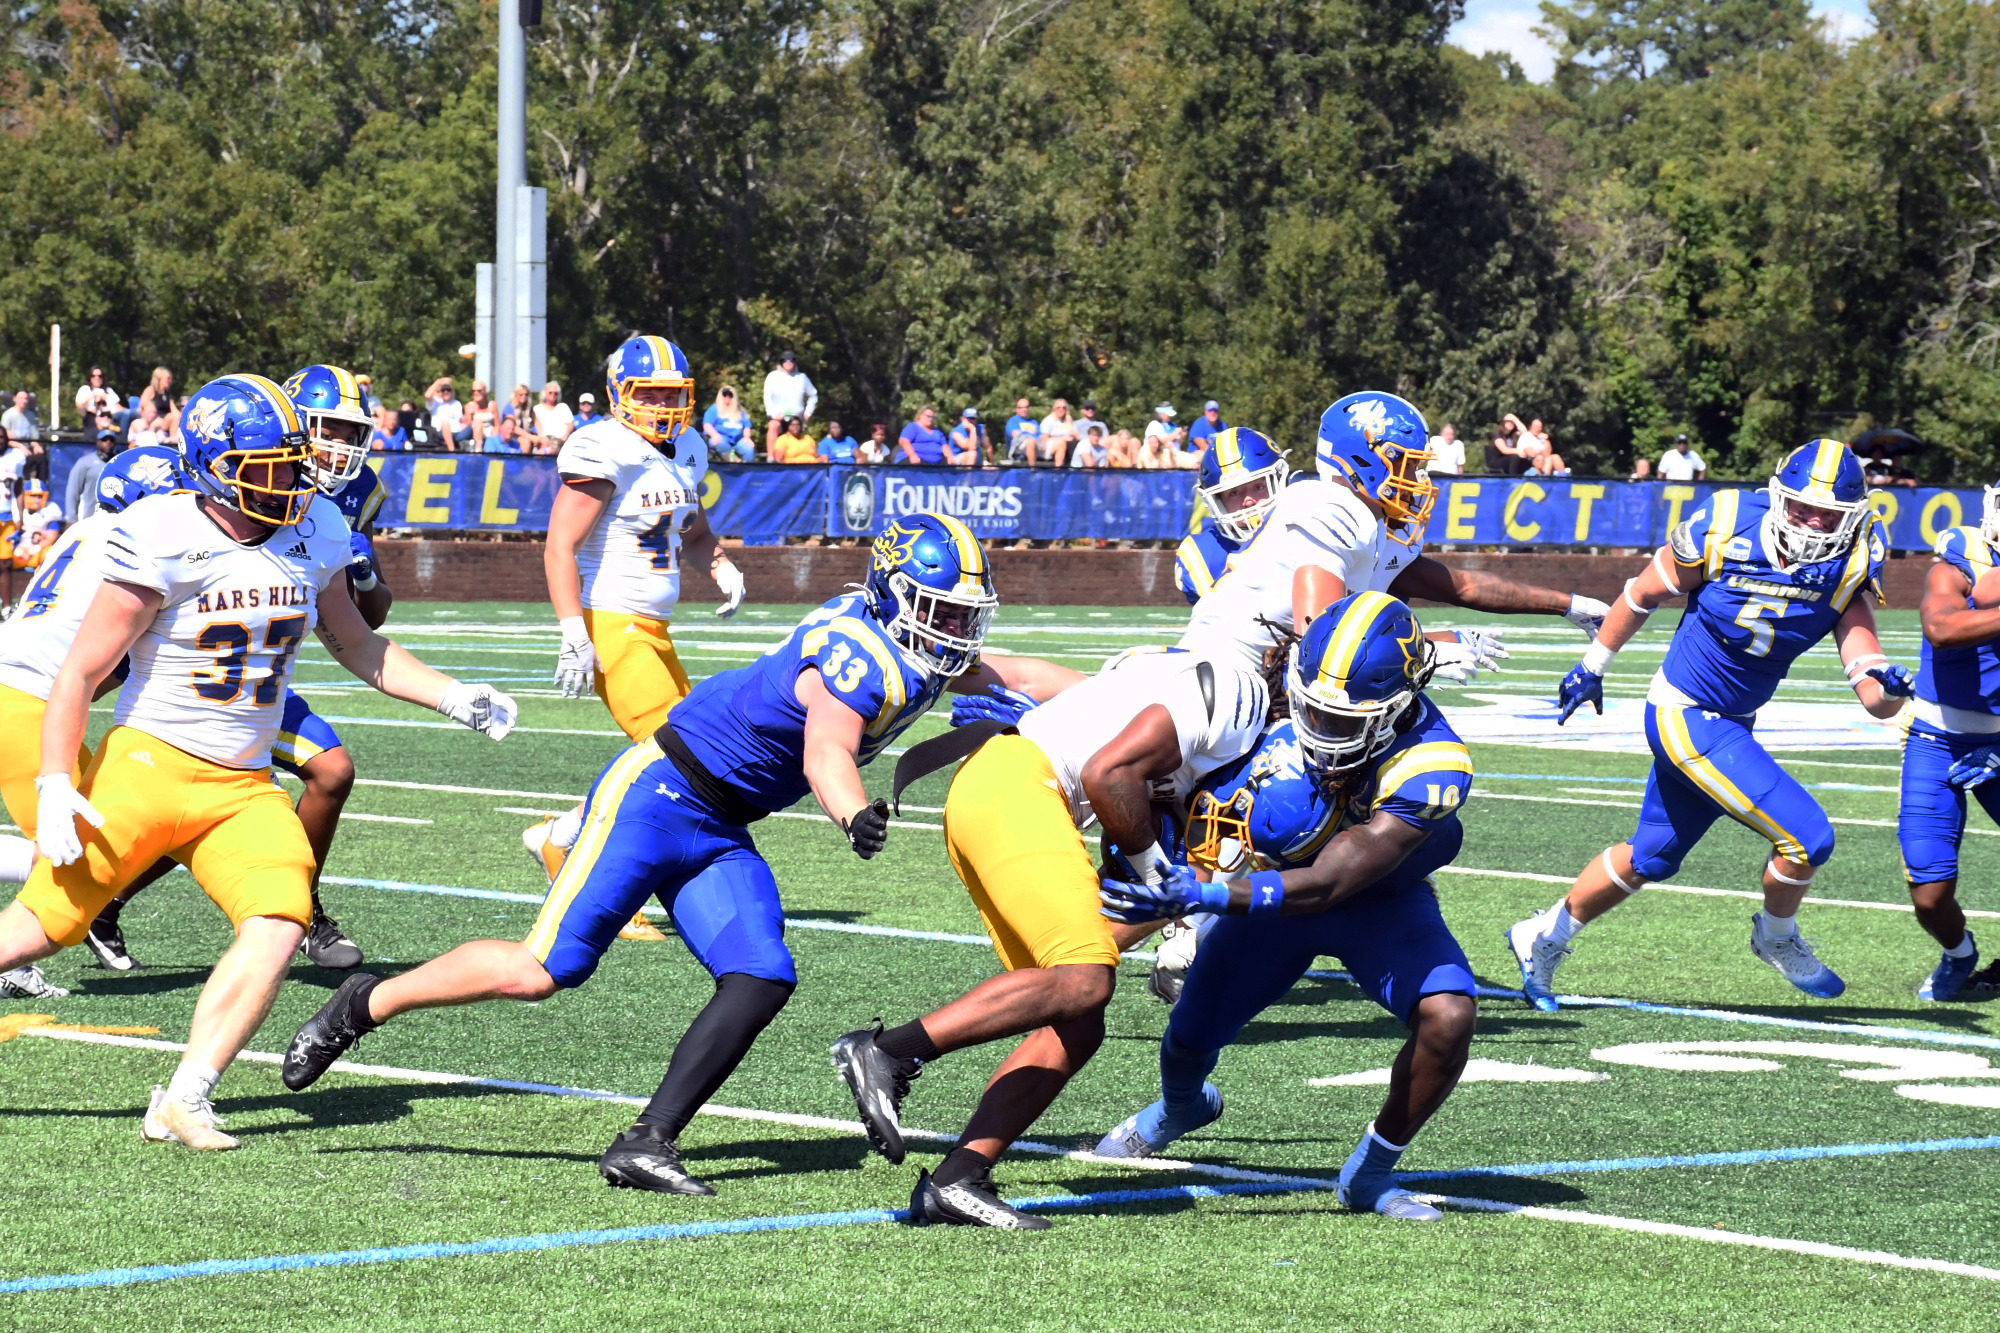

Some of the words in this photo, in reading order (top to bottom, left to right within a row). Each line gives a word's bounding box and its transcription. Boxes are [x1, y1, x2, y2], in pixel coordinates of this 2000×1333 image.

[366, 457, 519, 524] EL
[641, 489, 680, 508] MARS
[883, 477, 1023, 517] FOUNDERS
[1446, 482, 1605, 541] ECT
[1662, 486, 1696, 542] T
[1866, 491, 1963, 546] RO
[187, 551, 211, 563] SAC
[284, 550, 312, 561] adidas
[197, 588, 260, 614] MARS
[268, 585, 309, 607] HILL
[1734, 594, 1790, 657] 5
[189, 612, 309, 706] 37
[822, 641, 868, 693] 33
